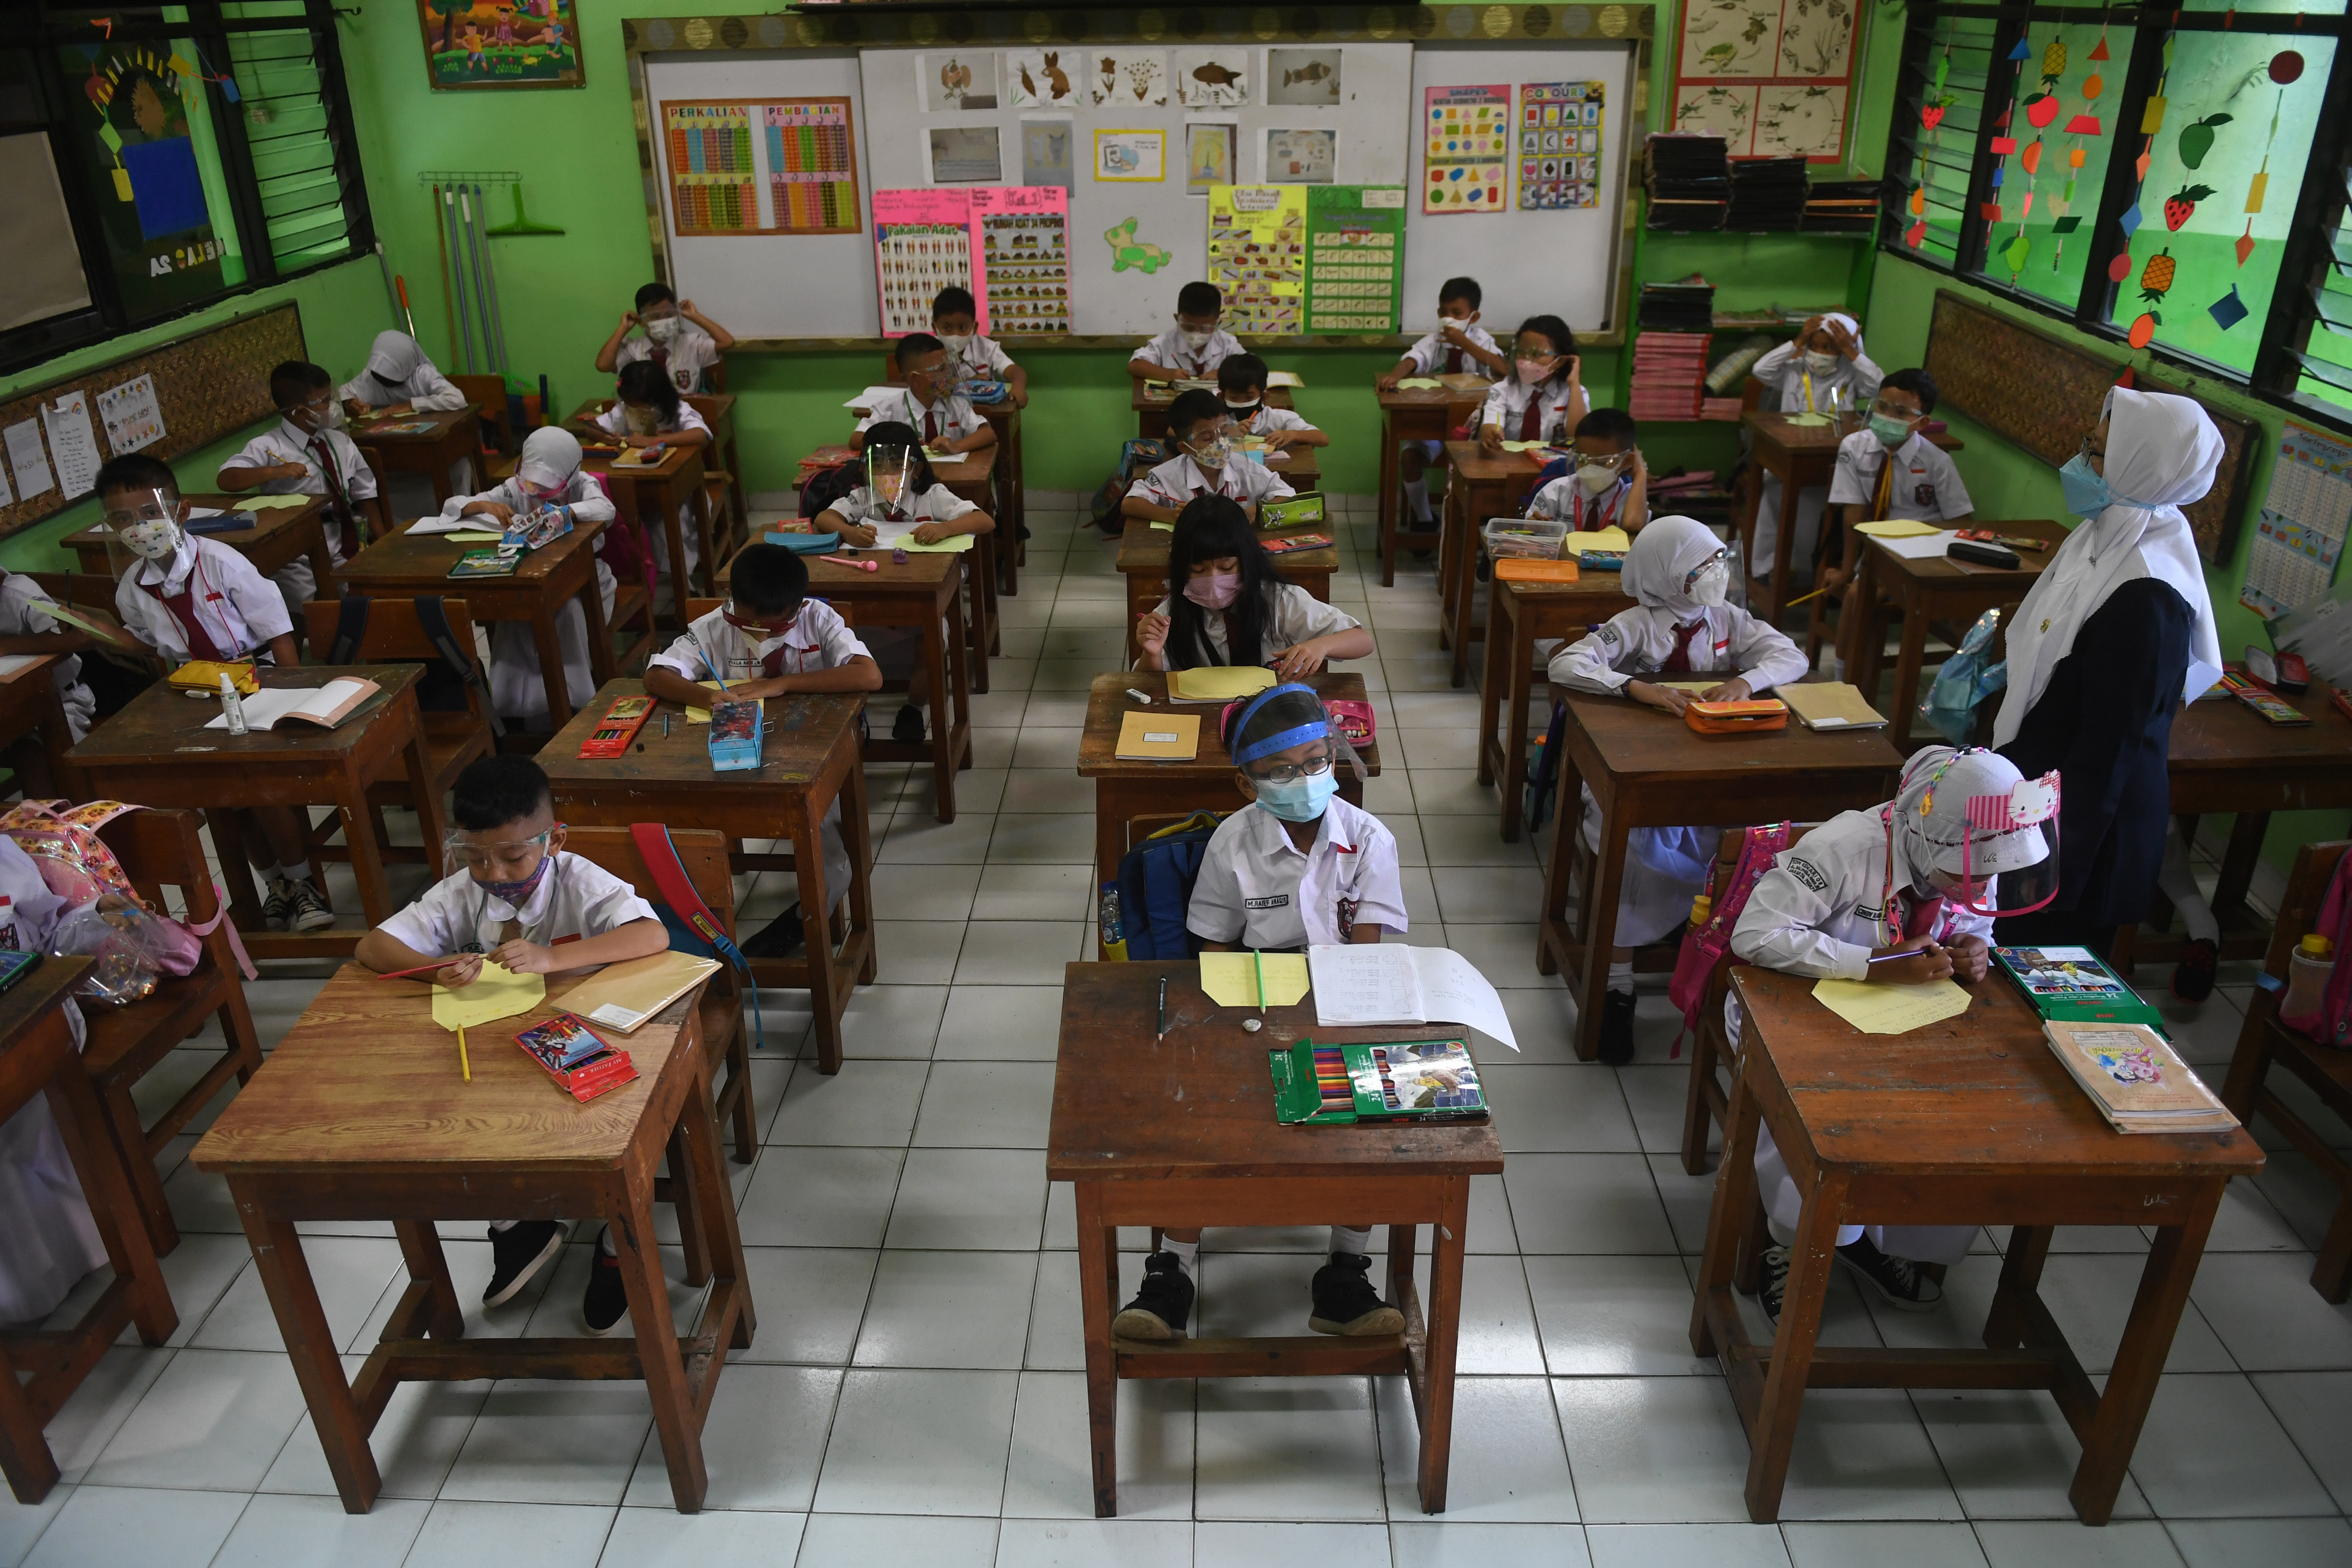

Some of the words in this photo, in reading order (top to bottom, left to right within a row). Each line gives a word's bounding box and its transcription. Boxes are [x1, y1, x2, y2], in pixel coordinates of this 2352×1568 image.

[1524, 86, 1586, 99] COLOURS
[670, 106, 747, 118] PERKALIAN
[769, 105, 840, 116] PEMBAGIAN
[887, 223, 929, 236] Pakaian
[931, 223, 958, 236] Adat
[590, 1061, 610, 1074] FATHER
[1371, 1093, 1381, 1102] 24
